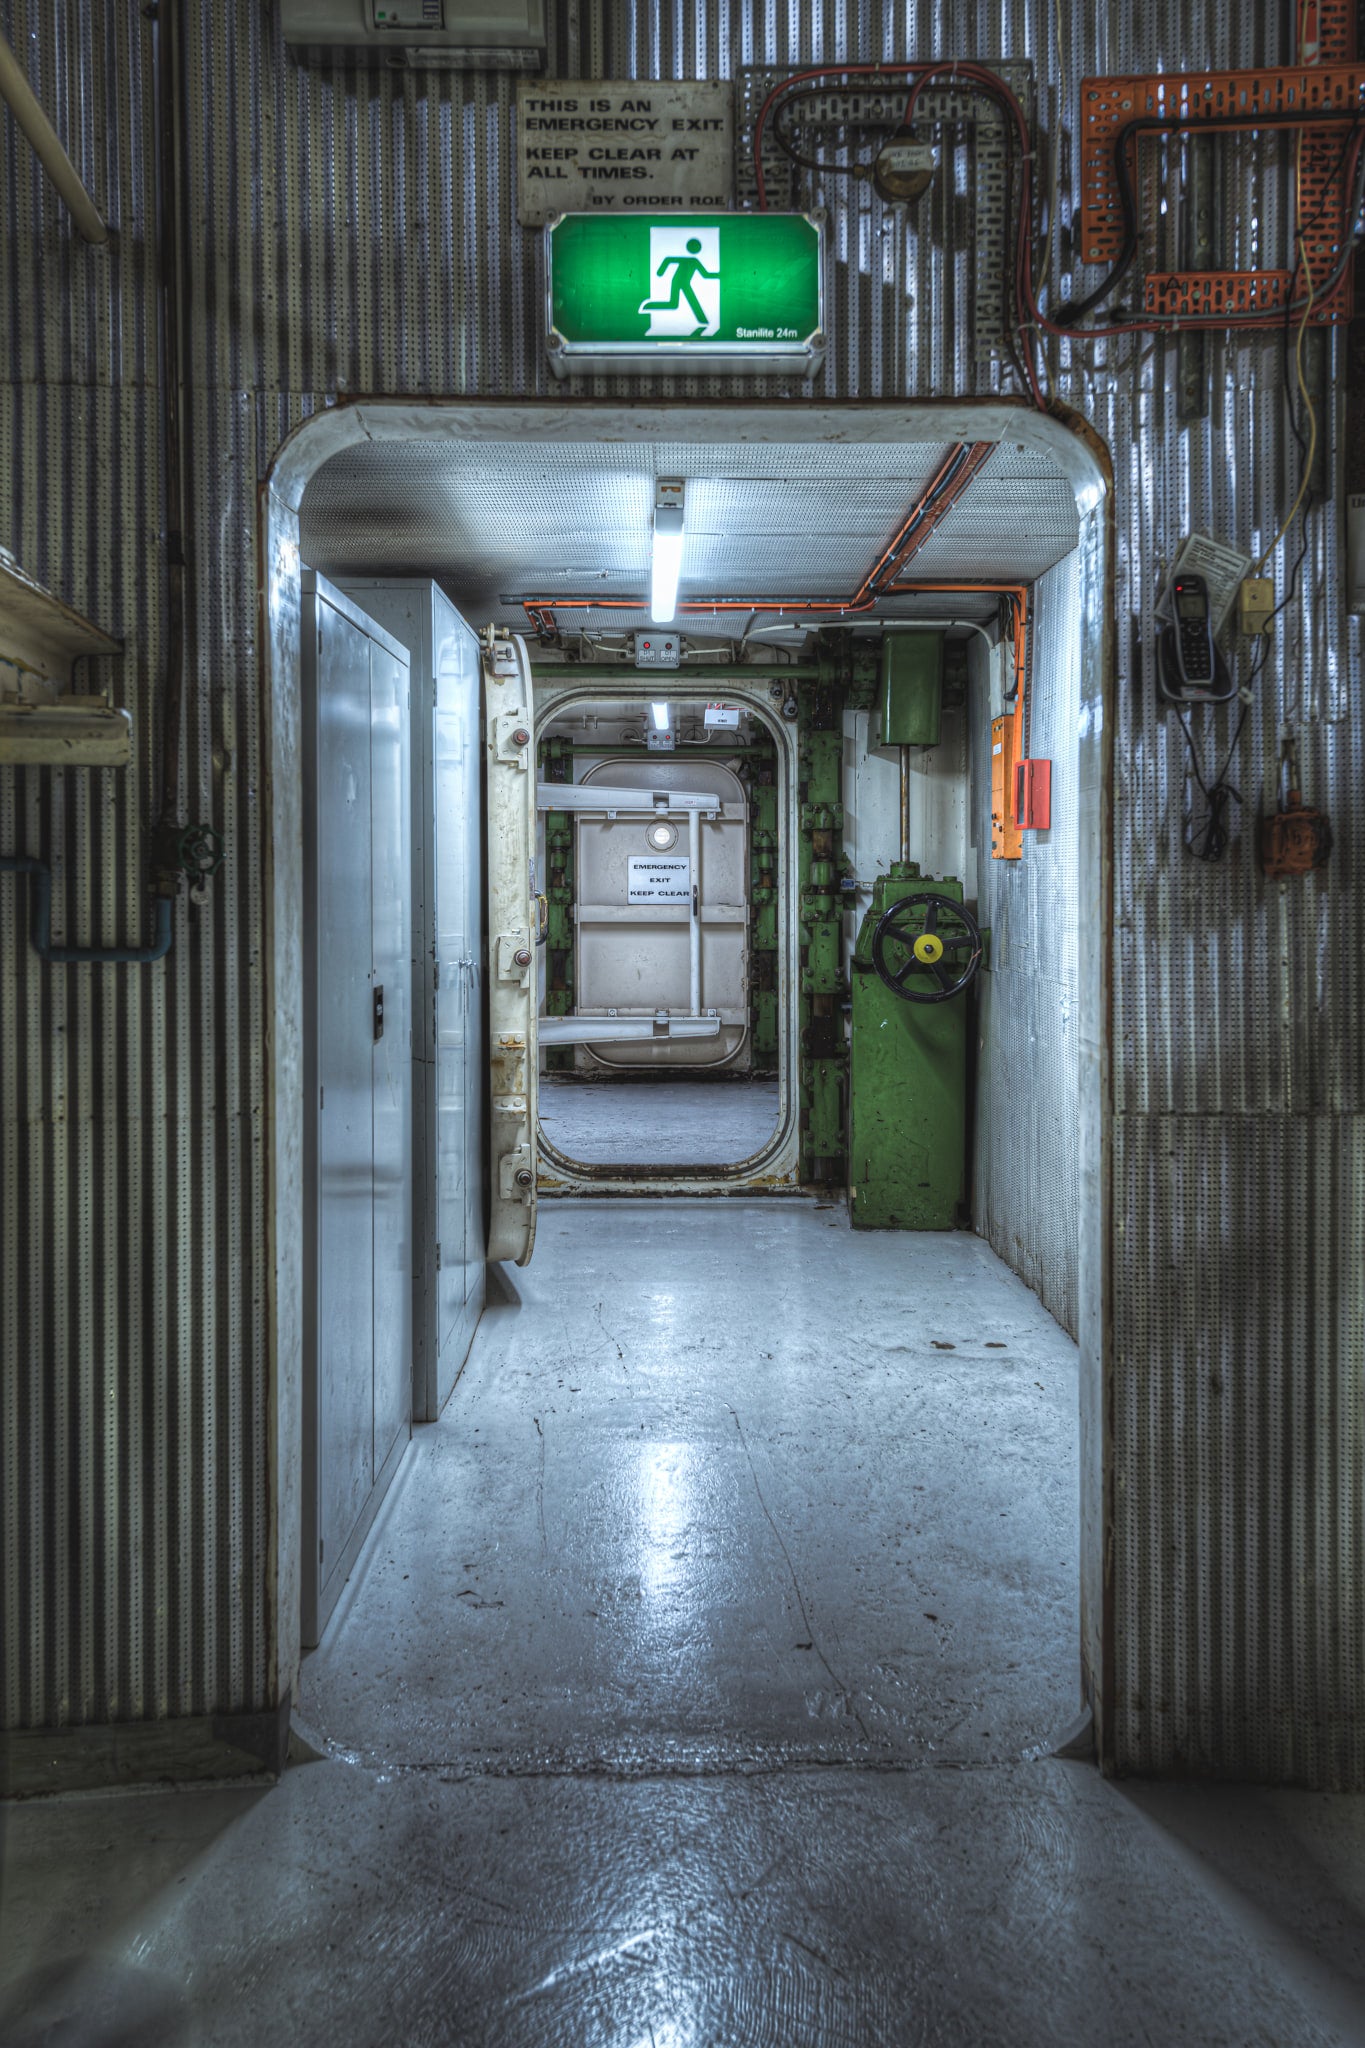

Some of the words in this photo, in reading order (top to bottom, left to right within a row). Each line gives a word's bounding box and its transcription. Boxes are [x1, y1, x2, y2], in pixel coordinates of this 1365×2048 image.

[525, 99, 578, 112] THIS
[590, 99, 611, 112] IS
[620, 100, 651, 112] AN
[525, 118, 659, 131] EMERGENCY
[672, 119, 724, 131] EXIT.
[526, 147, 578, 160] KEEP
[588, 148, 661, 160] CLEAR
[670, 148, 699, 160] AT
[527, 166, 568, 179] ALL
[577, 166, 654, 179] TIMES.
[592, 195, 615, 205] BY
[622, 195, 683, 205] ORDER
[736, 326, 774, 338] Stanilite
[776, 327, 798, 338] 24m
